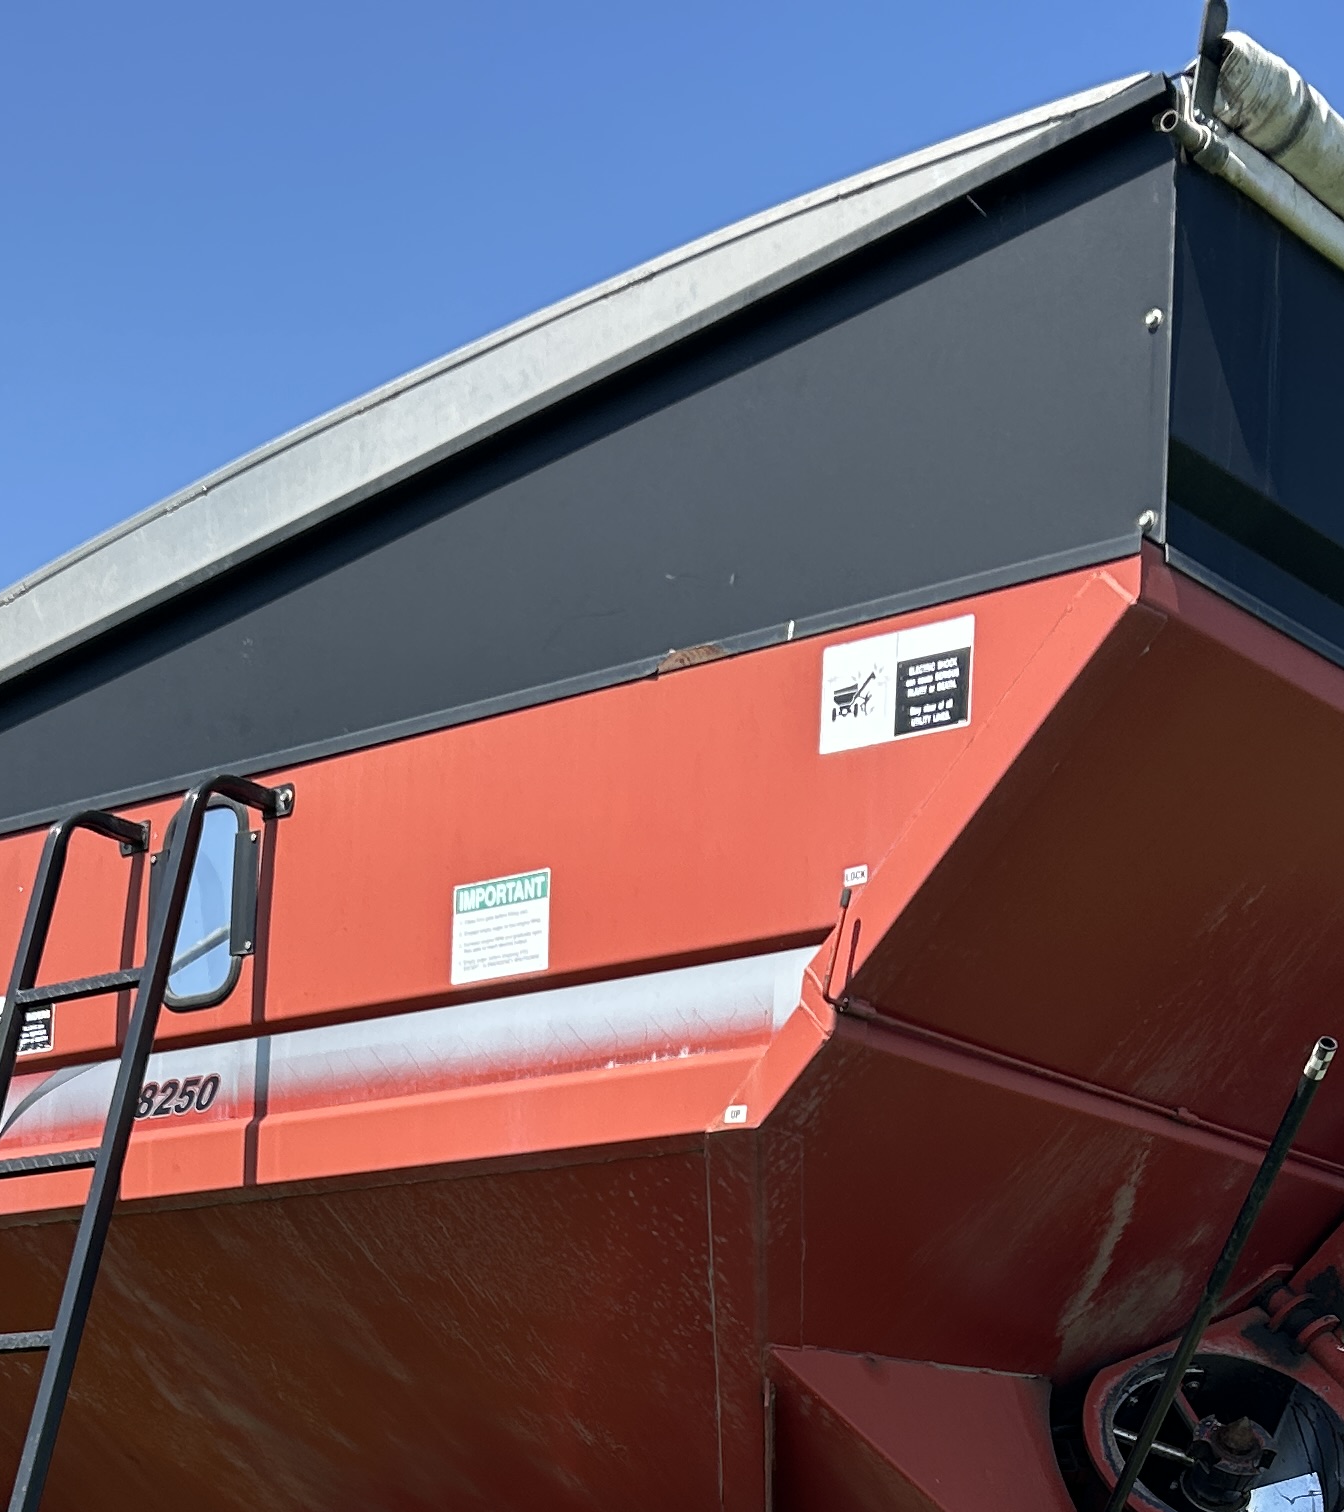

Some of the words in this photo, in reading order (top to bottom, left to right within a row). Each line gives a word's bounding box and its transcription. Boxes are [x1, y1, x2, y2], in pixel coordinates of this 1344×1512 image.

[458, 875, 546, 912] IMPORTANT
[846, 870, 865, 882] LOCK
[134, 1073, 221, 1119] 8250
